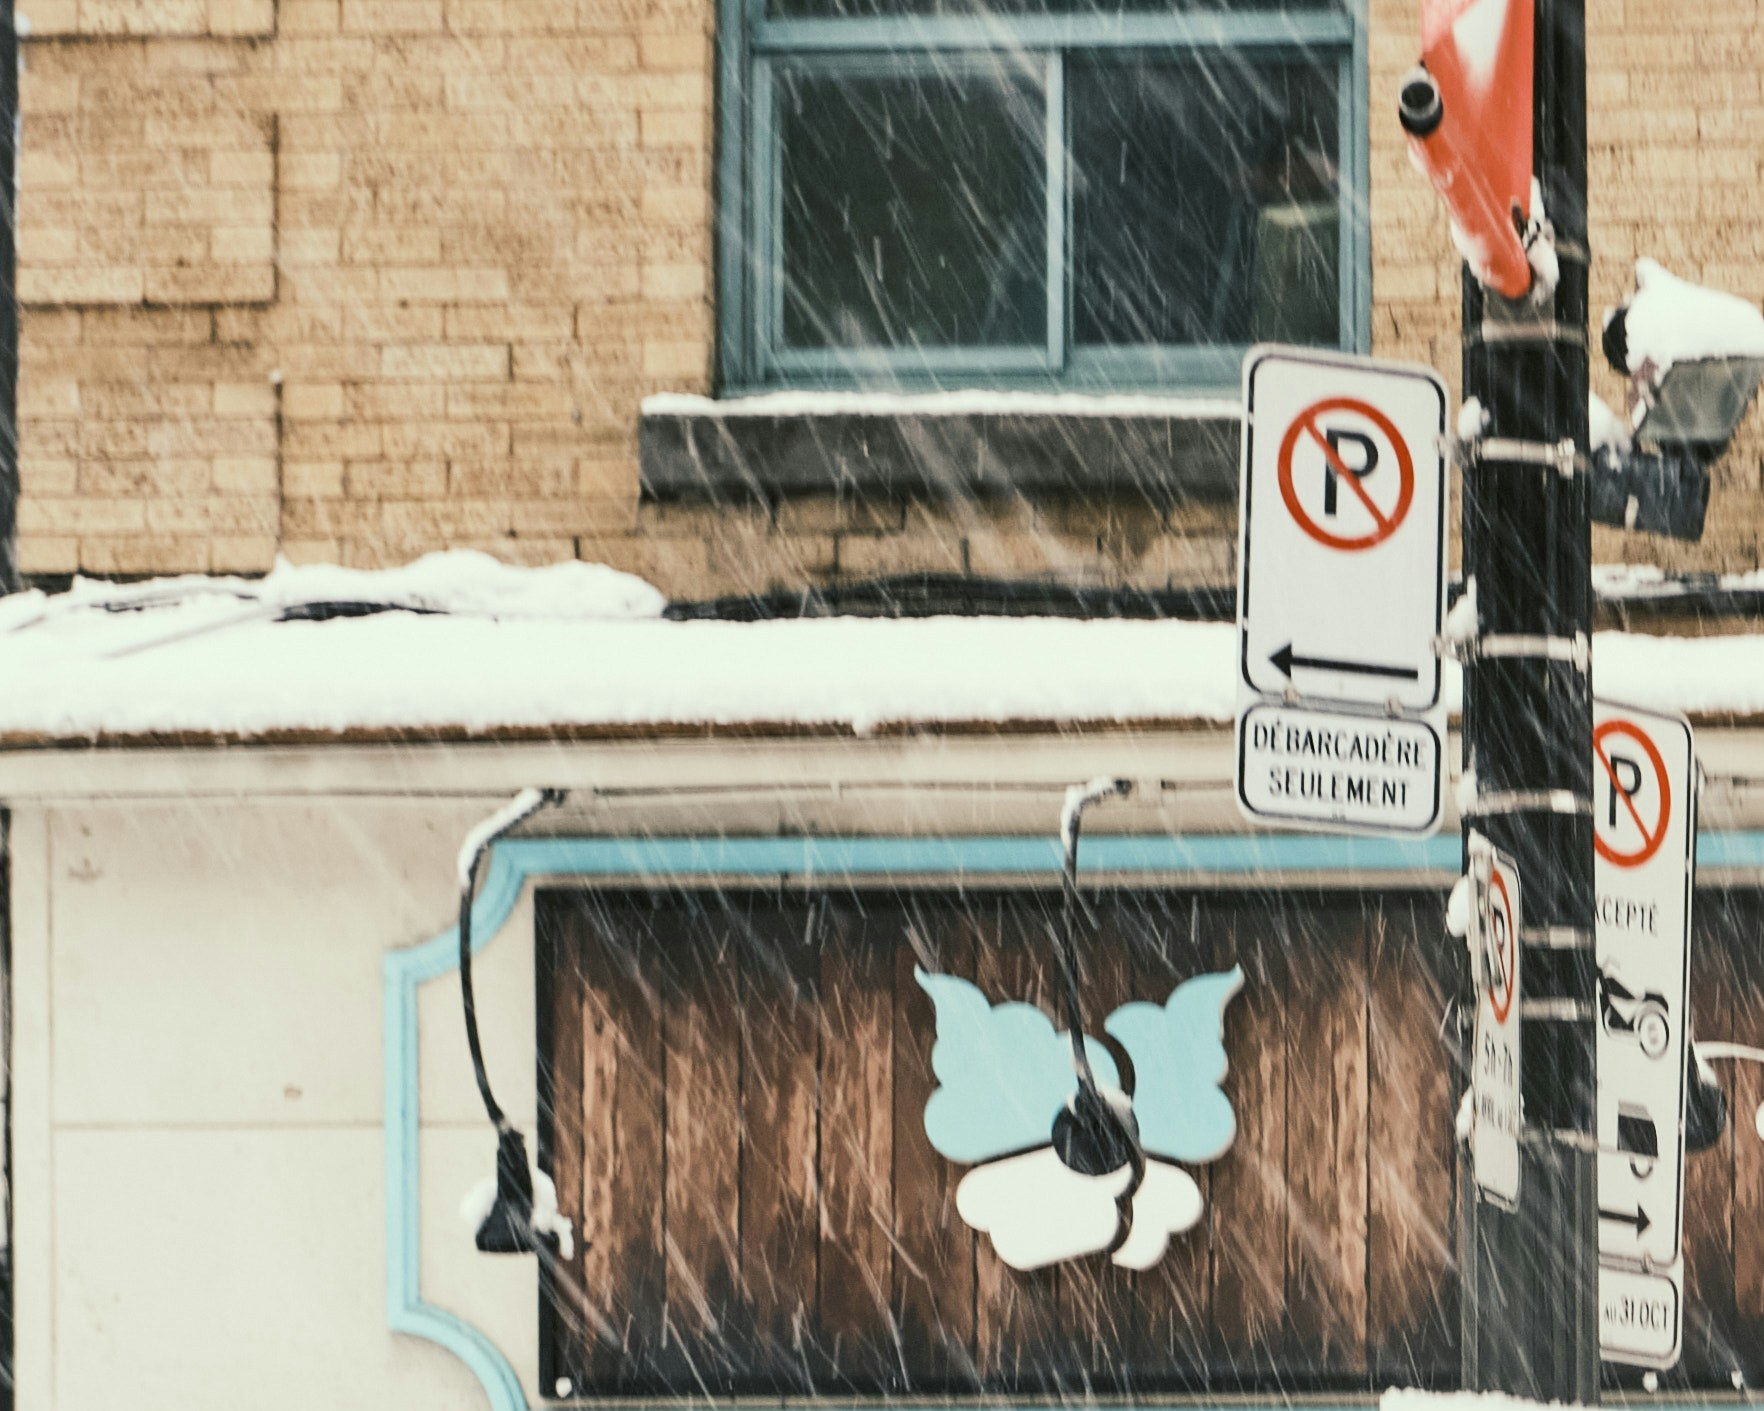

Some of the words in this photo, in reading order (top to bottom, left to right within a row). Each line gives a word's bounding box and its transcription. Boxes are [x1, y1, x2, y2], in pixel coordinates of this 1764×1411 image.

[1253, 717, 1427, 770] DÉBARCADÈRE
[1269, 766, 1410, 810] SEULEMENT
[1639, 1298, 1669, 1332] OCT
